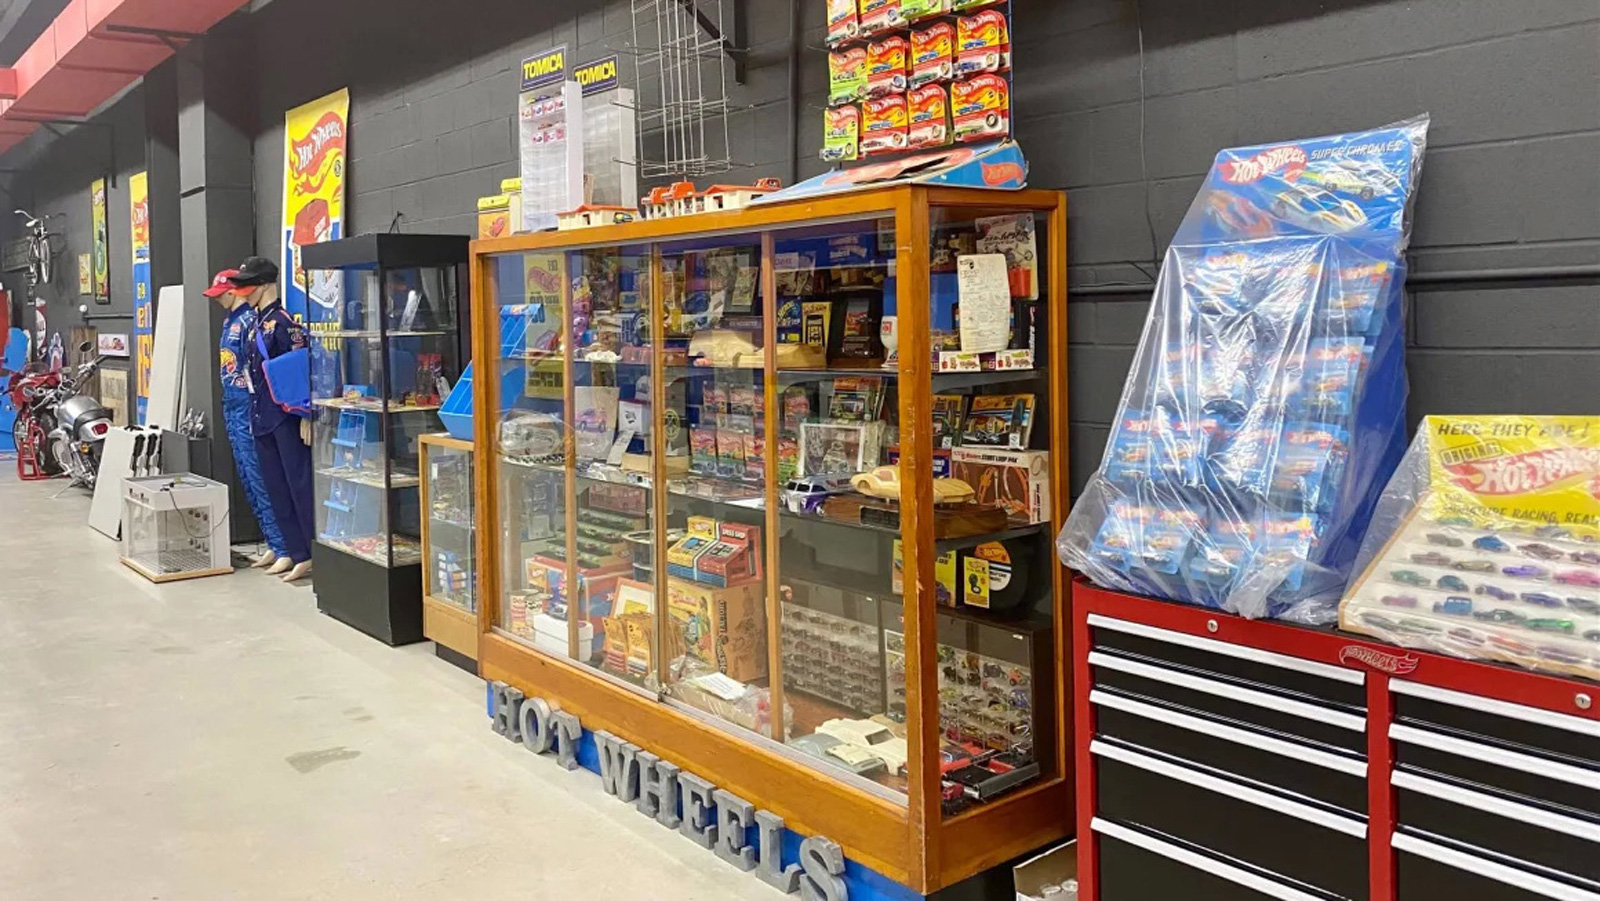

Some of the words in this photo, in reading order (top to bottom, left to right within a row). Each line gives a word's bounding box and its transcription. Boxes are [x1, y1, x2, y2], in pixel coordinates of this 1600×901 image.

[523, 52, 563, 80] TOMICA
[575, 61, 616, 86] TOMICA
[1492, 424, 1534, 437] THEY
[492, 680, 582, 771] HOT
[595, 729, 849, 901] WHEELS
